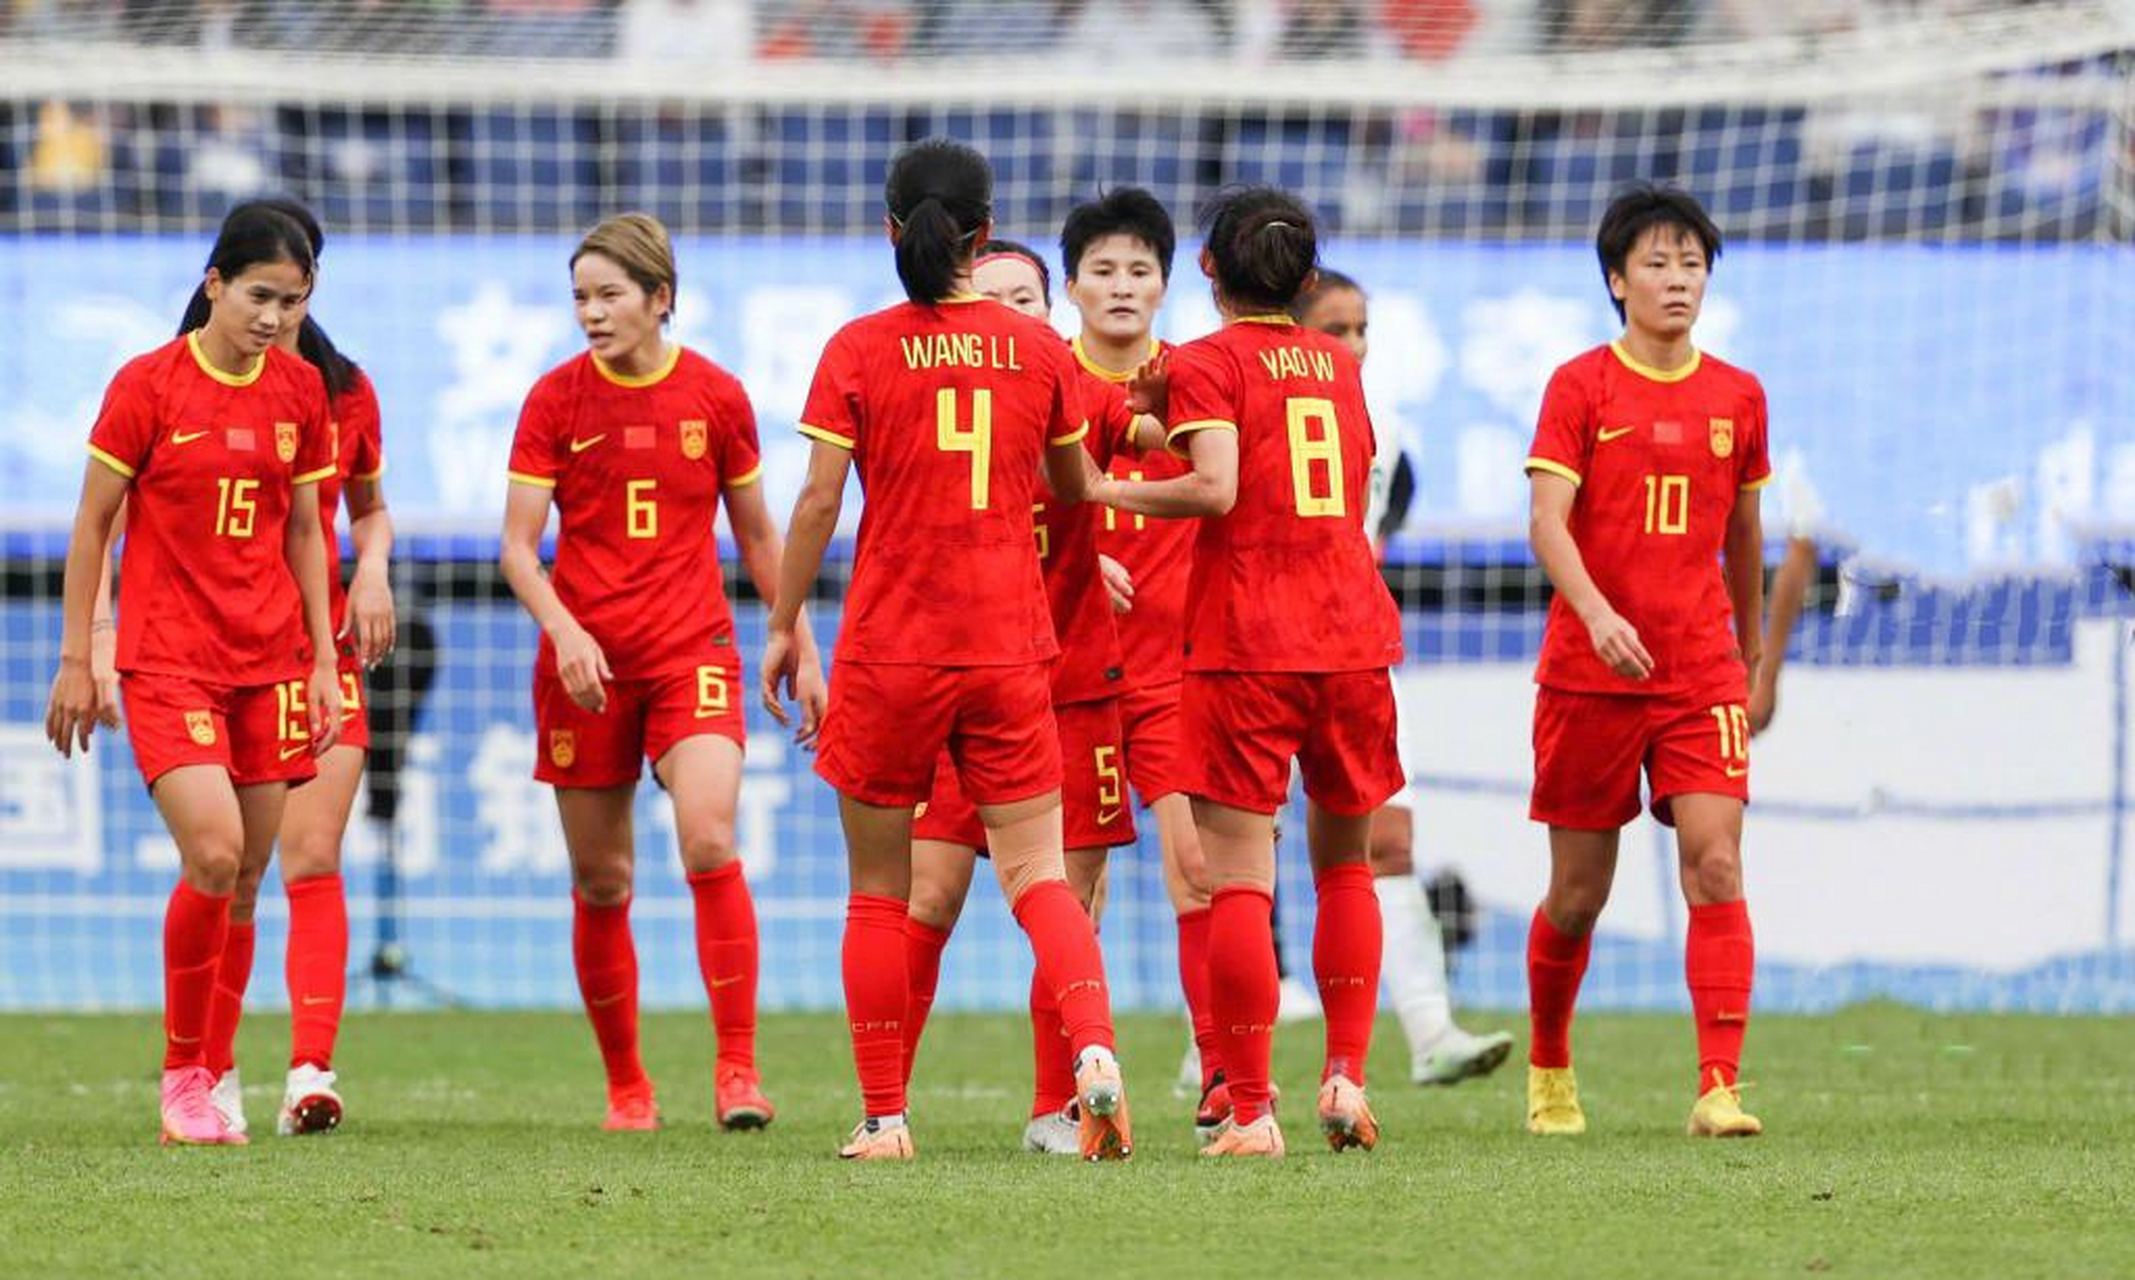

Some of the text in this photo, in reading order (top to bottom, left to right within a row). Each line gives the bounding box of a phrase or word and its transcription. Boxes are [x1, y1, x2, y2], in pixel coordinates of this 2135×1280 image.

[901, 333, 985, 370] WANG
[1258, 346, 1335, 382] YAO W
[936, 388, 992, 511] 4
[1285, 396, 1346, 518] 8
[215, 478, 260, 537] 15
[626, 480, 657, 538] 6
[1645, 475, 1689, 535] 10
[696, 665, 730, 709] 6
[1710, 704, 1749, 760] 10
[1095, 746, 1121, 806] 5
